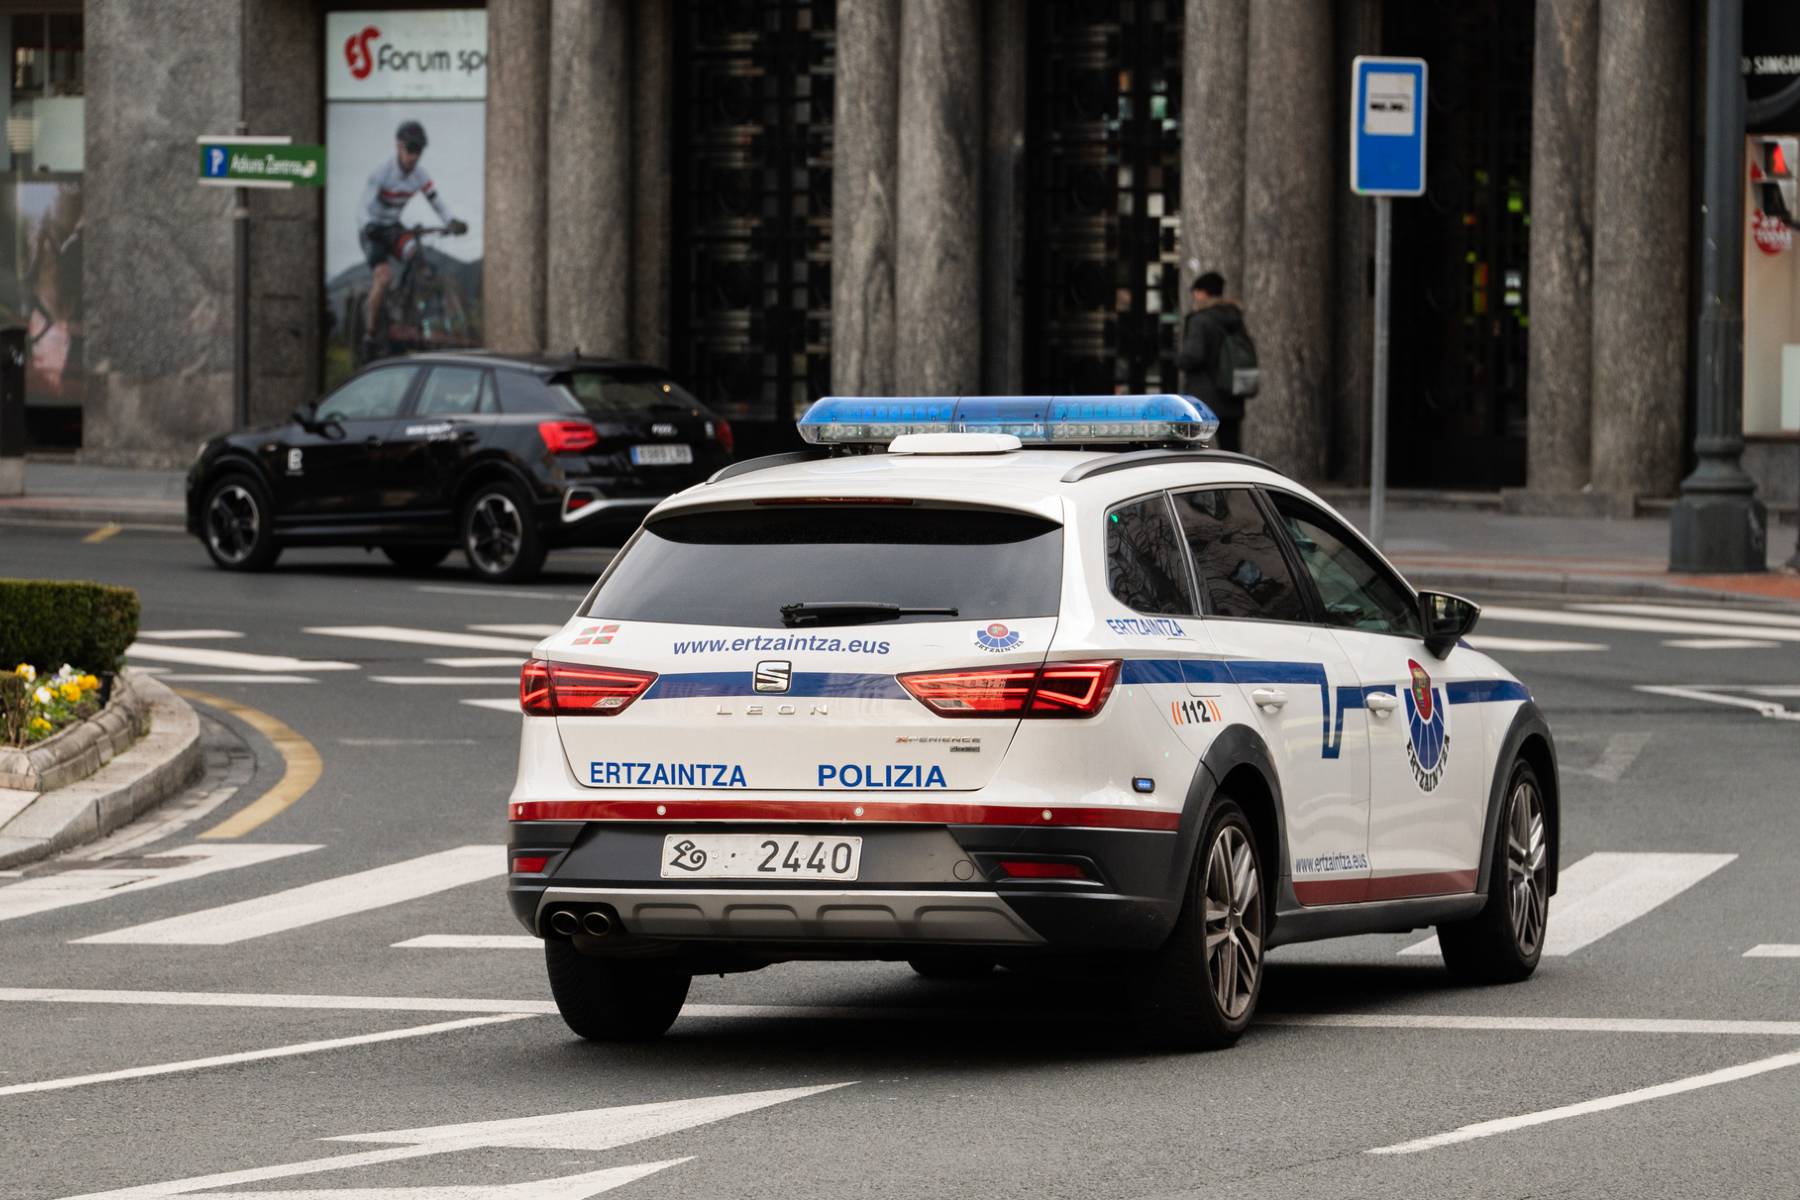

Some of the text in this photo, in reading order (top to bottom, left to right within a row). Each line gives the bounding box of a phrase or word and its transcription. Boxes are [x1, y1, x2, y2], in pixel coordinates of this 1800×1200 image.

[1106, 619, 1186, 637] ERTZAINTZA
[673, 634, 891, 655] www.ertzaintza.eus
[716, 704, 828, 716] LEON
[590, 762, 948, 788] ERTZAINTZA POLIZIA
[757, 840, 852, 874] 2440
